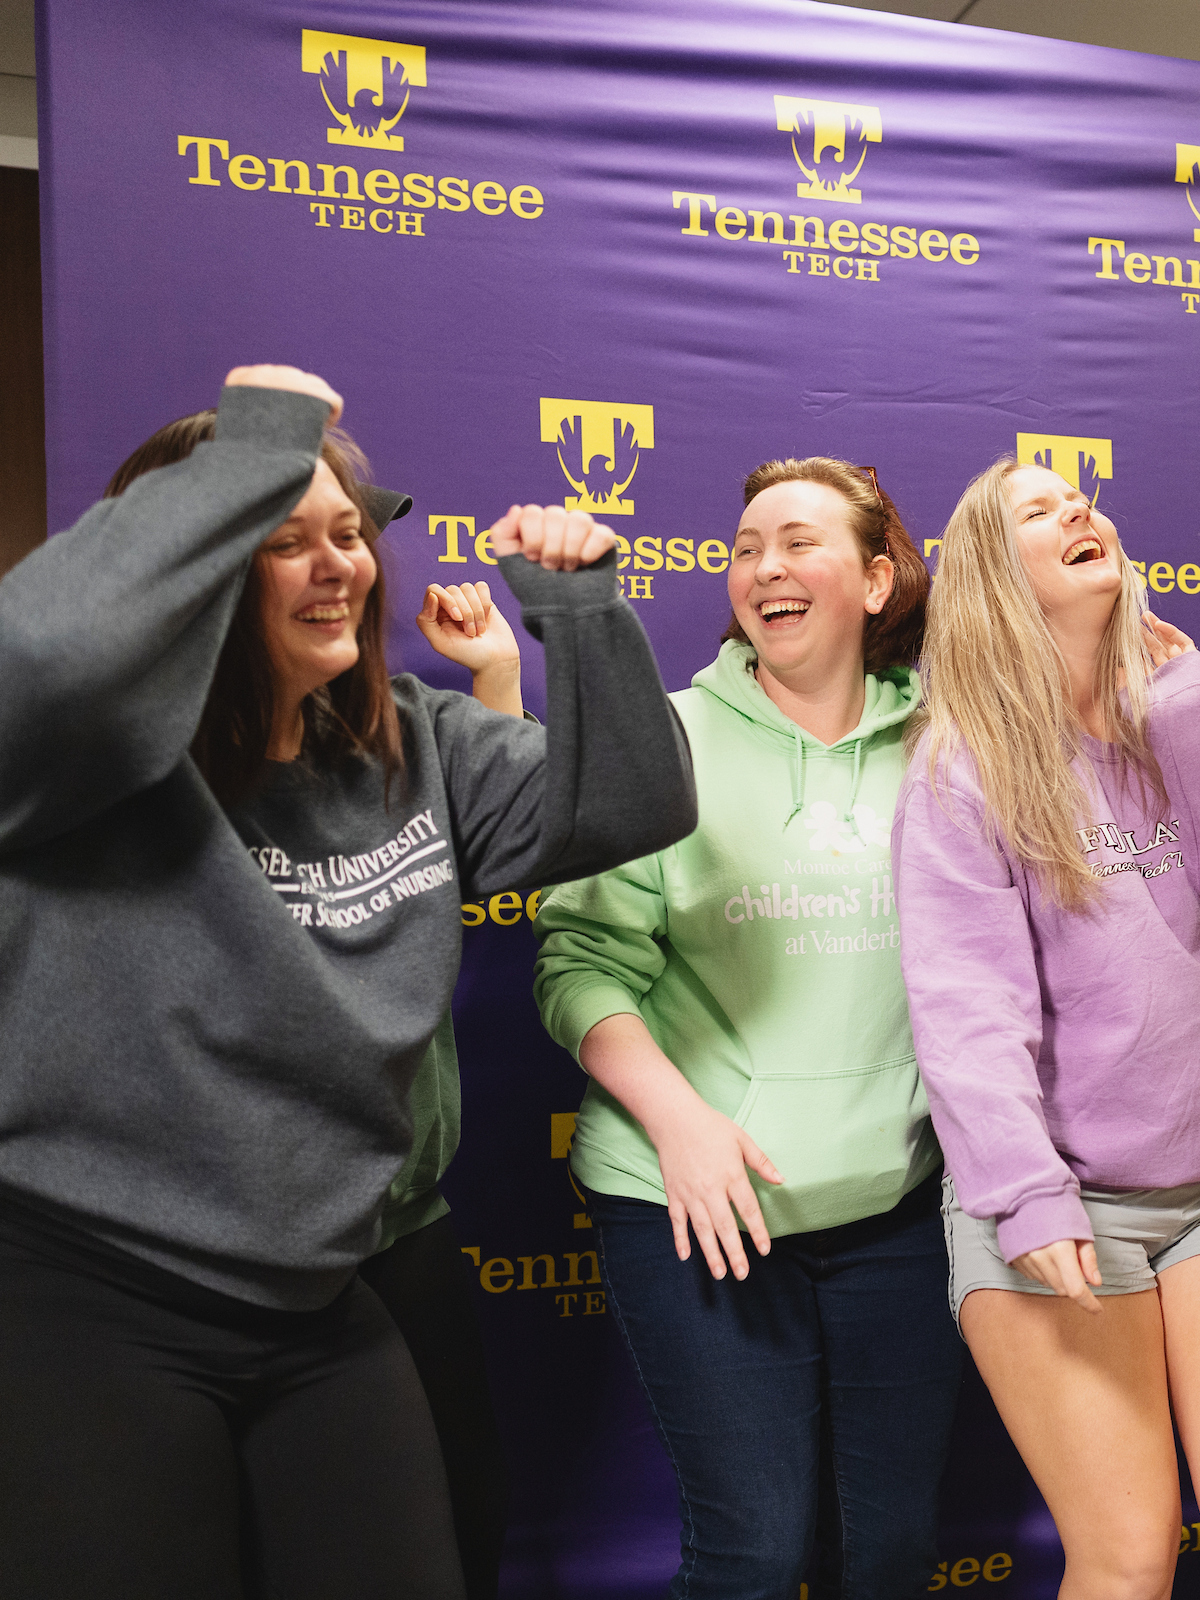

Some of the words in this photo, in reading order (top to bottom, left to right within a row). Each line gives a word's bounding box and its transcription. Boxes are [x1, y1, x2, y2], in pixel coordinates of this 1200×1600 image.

[178, 135, 544, 219] Tennessee
[310, 202, 426, 237] TECH
[671, 190, 980, 266] Tennessee
[782, 250, 881, 282] TECH
[428, 514, 737, 574] Teesse
[328, 809, 439, 887] UNIVERSITY
[783, 859, 850, 876] Monroe
[853, 858, 893, 875] Care
[316, 901, 373, 928] SCHOOL
[369, 888, 393, 913] OF
[390, 858, 454, 902] NURSING
[784, 934, 807, 955] at
[808, 923, 901, 955] Vanderb
